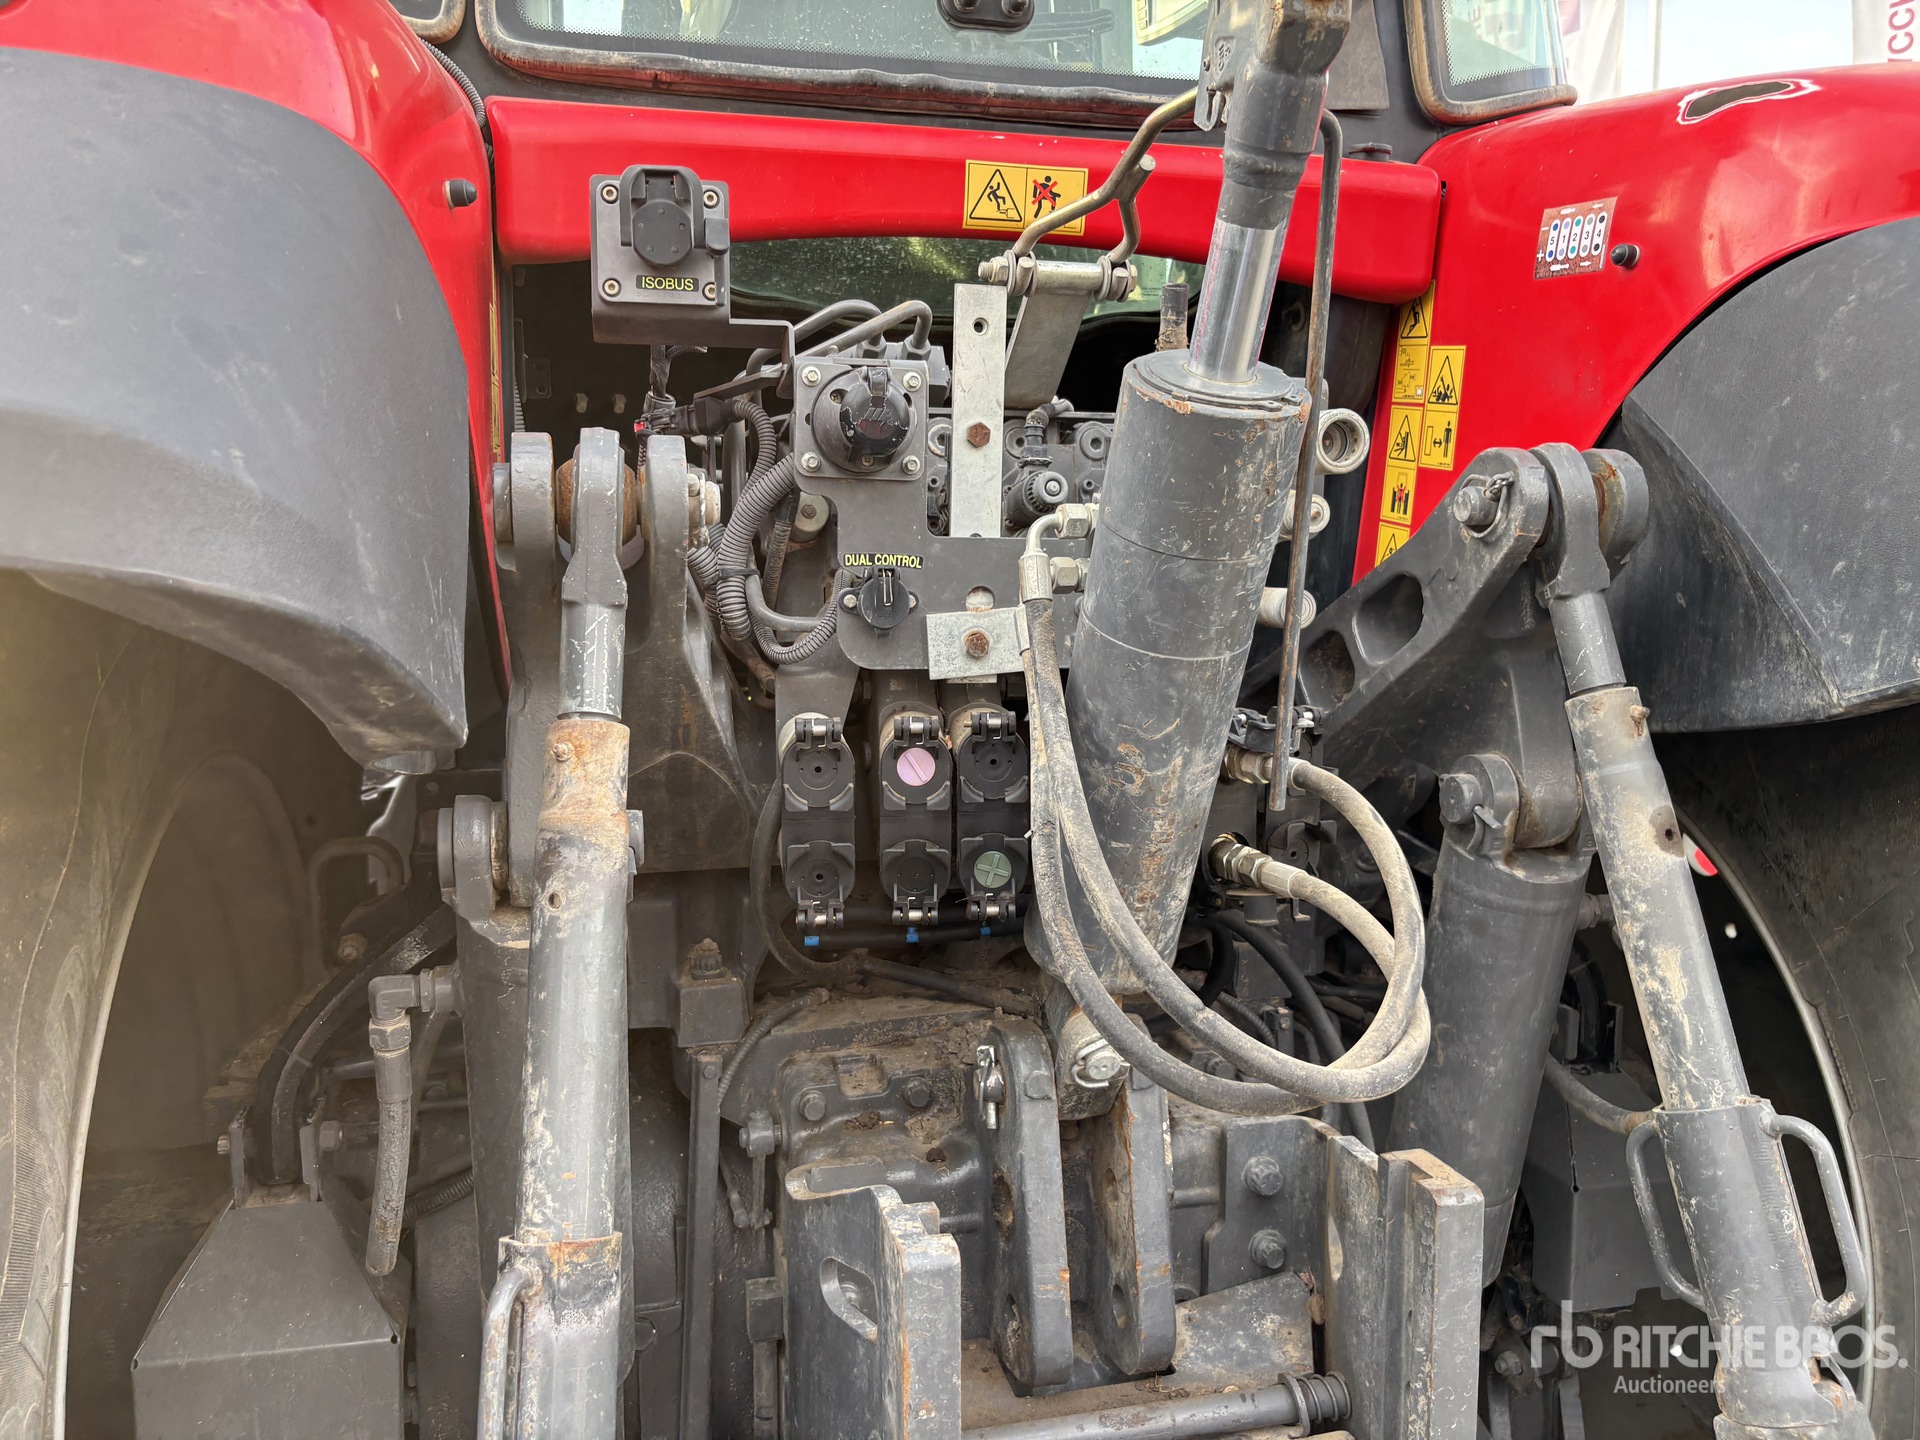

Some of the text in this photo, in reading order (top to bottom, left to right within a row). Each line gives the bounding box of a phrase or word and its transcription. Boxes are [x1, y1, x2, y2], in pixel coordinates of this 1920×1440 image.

[641, 276, 694, 291] ISOBUS
[844, 553, 922, 569] DUAL CONTROL
